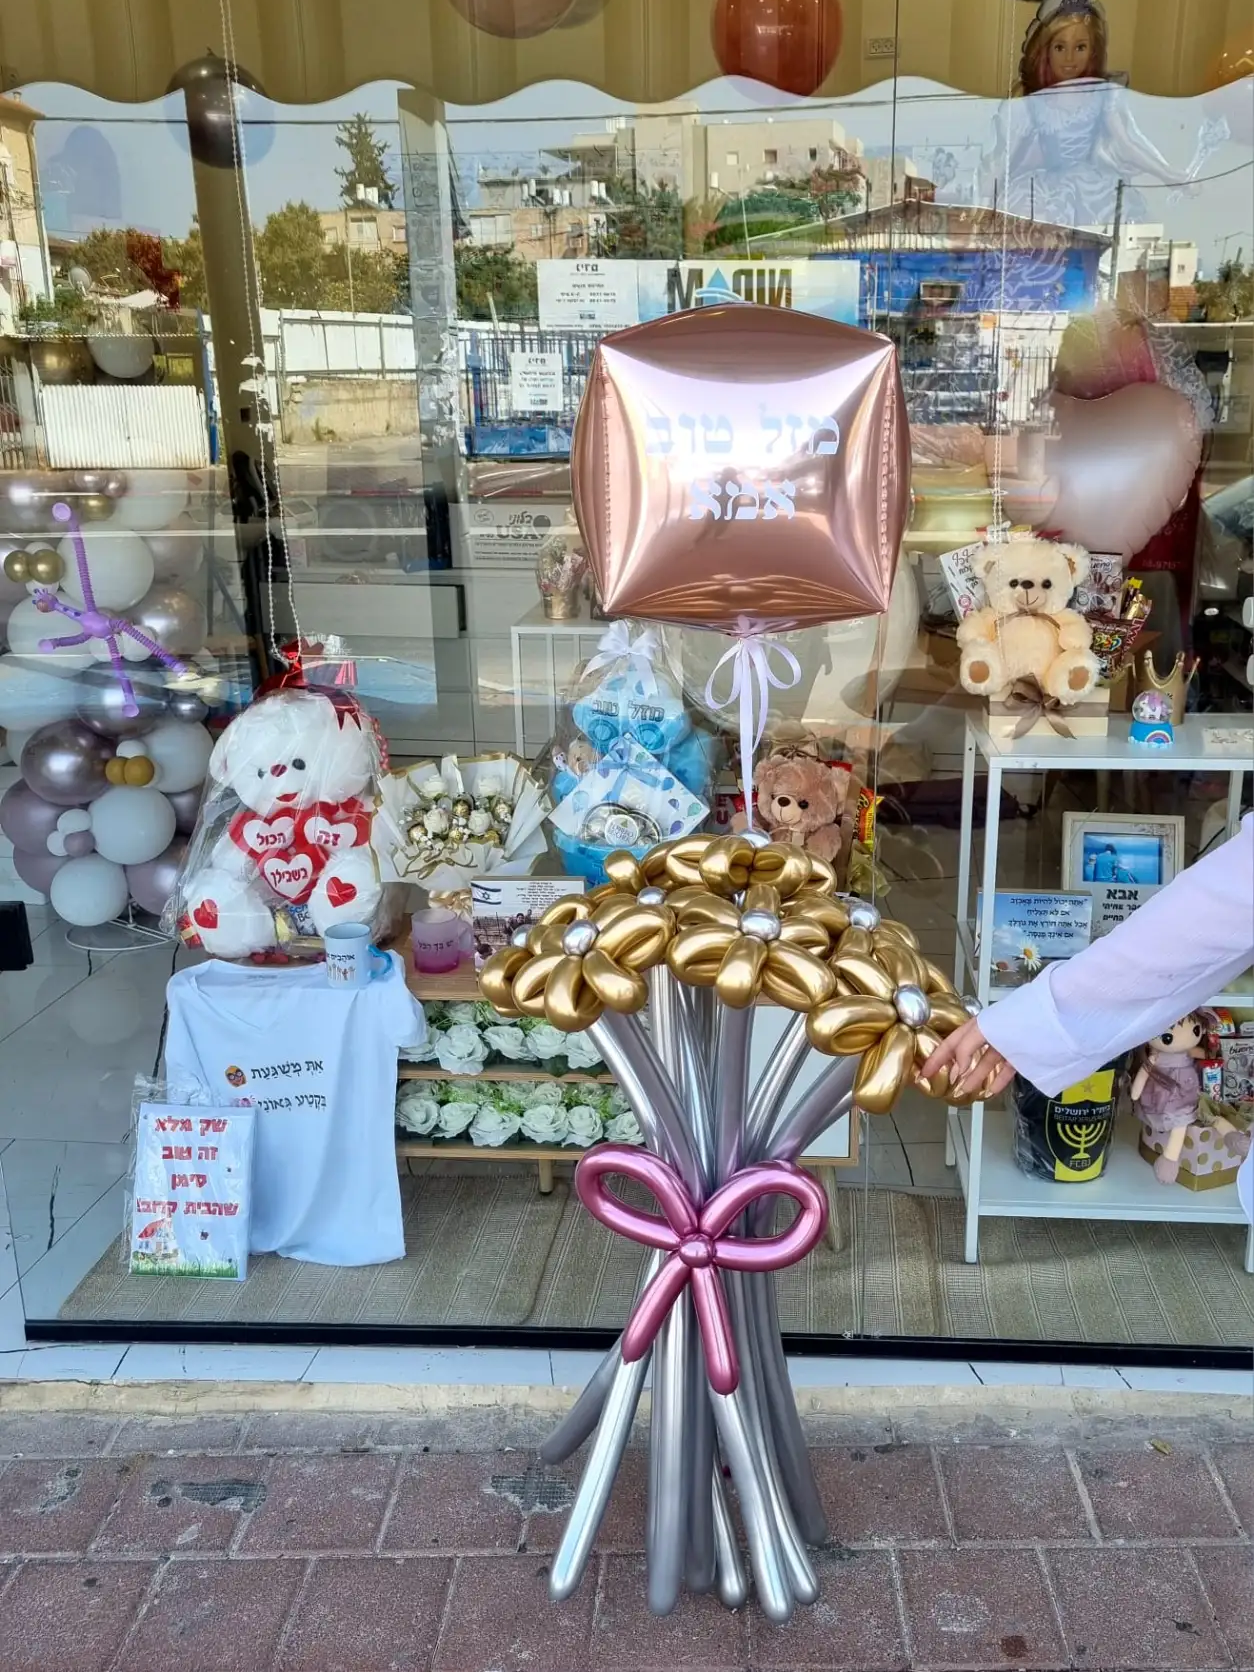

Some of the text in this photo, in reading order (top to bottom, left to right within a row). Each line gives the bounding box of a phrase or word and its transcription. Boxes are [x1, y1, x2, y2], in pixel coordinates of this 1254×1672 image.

[646, 402, 840, 454] מזל טוב
[688, 478, 796, 520] אמא
[592, 700, 665, 722] מזל טוב
[317, 831, 341, 846] זה
[1106, 888, 1139, 900] אבא
[199, 1118, 228, 1136] שק
[198, 1146, 218, 1160] זה
[171, 1174, 208, 1190] סימן
[183, 1201, 239, 1216] שהבית
